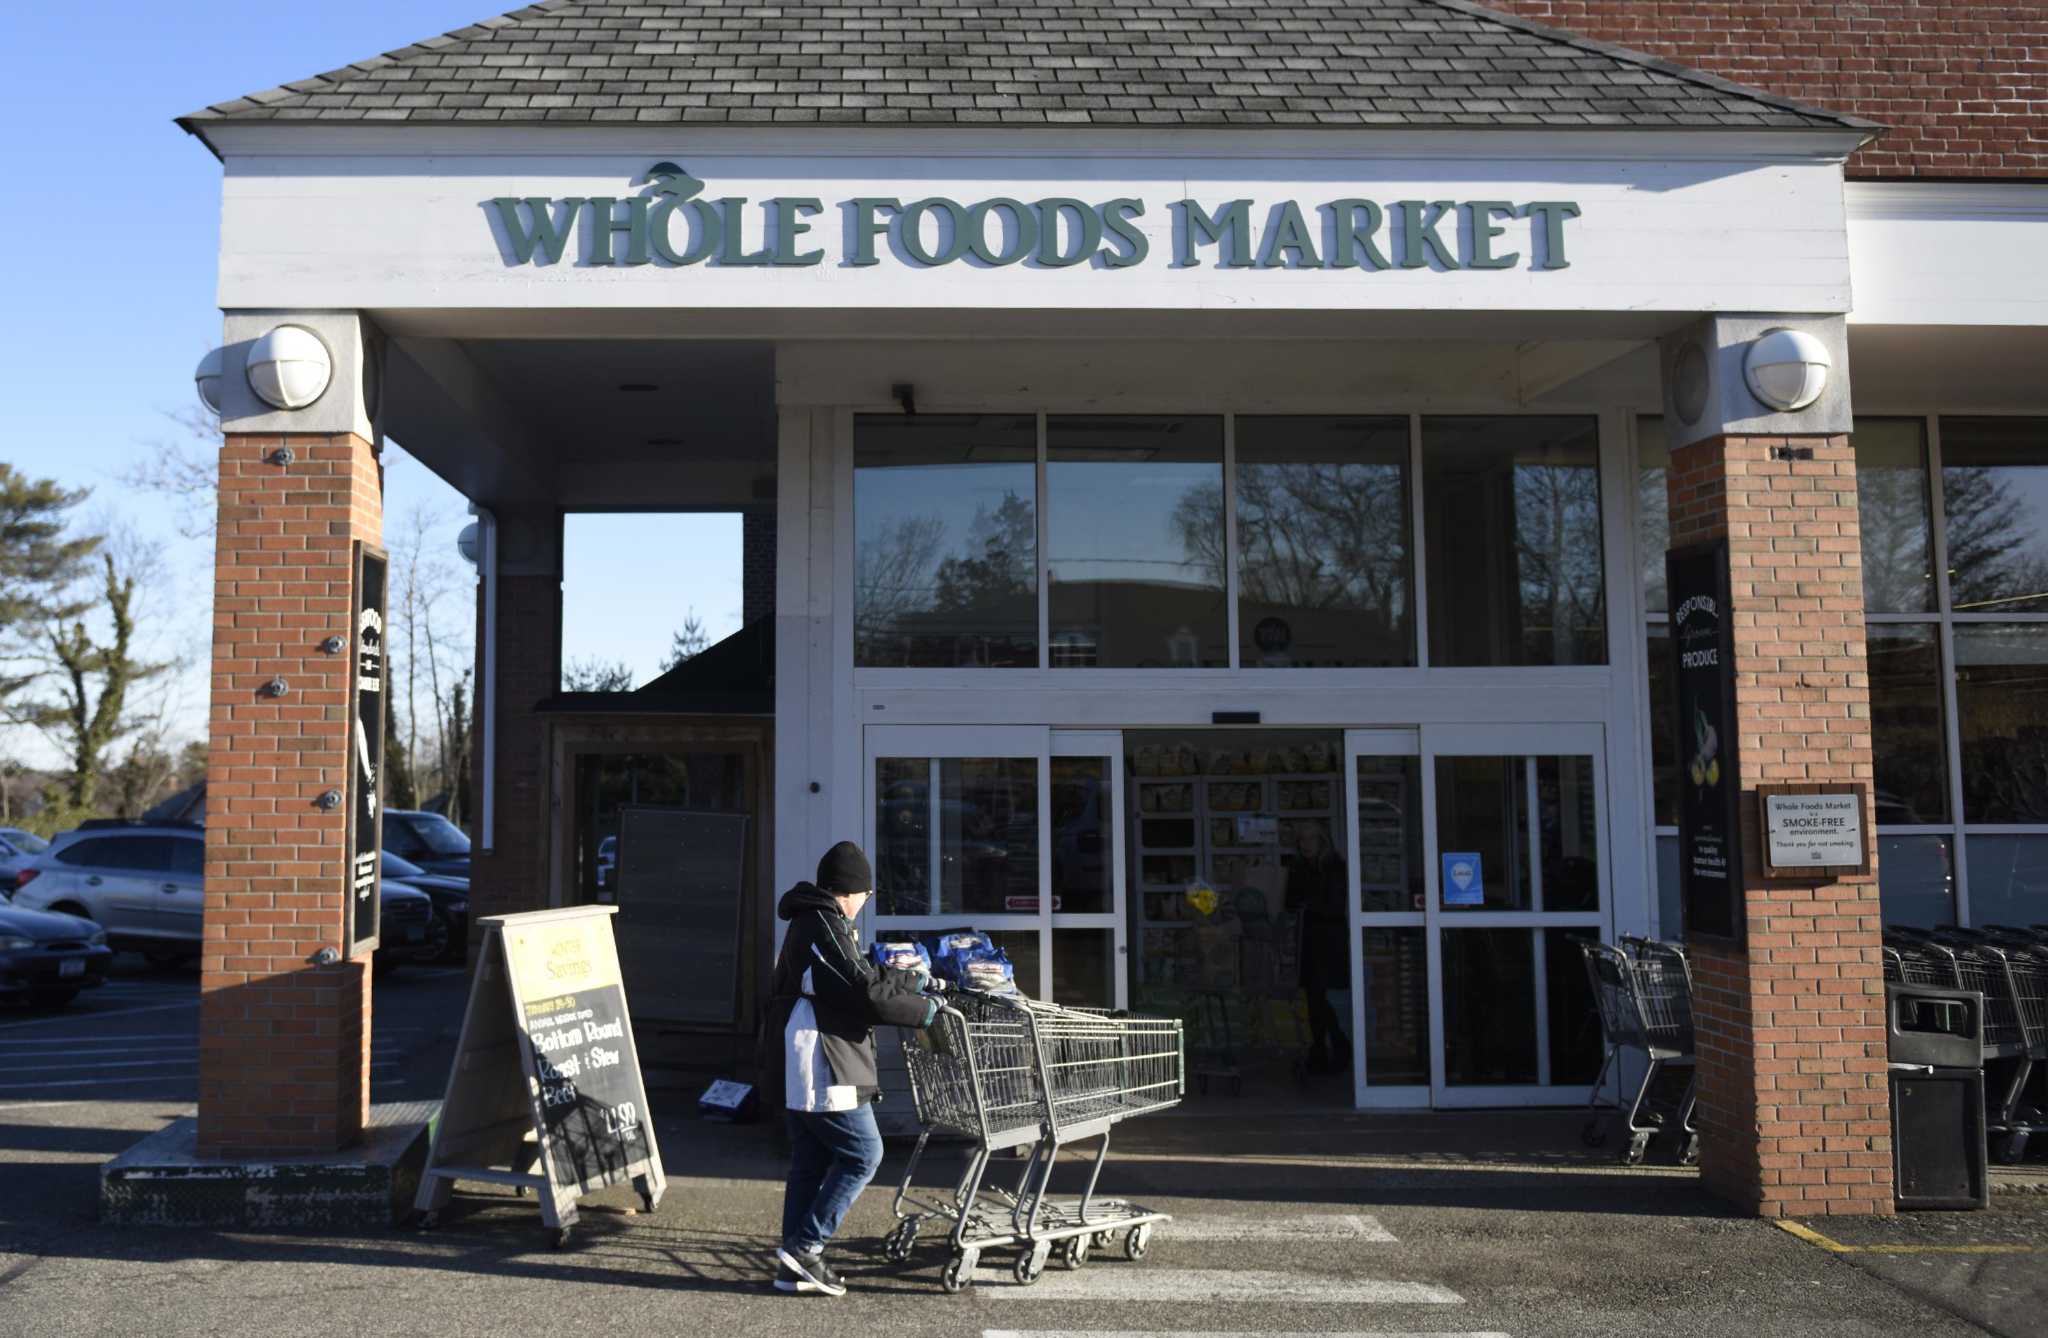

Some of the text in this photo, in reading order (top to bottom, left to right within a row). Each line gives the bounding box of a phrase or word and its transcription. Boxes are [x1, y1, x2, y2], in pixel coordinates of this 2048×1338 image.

[492, 188, 1582, 271] WHOLE FOODS MARKET
[1682, 648, 1719, 668] PRODUCE
[1775, 801, 1851, 811] Whole Foods Market
[1782, 817, 1845, 828] SMOKE-FREE
[1807, 841, 1816, 849] for
[545, 959, 592, 981] Savings
[531, 1017, 624, 1054] Bottom Round
[537, 1054, 581, 1082] Roast
[590, 1046, 620, 1069] Stew
[543, 1080, 577, 1107] Beef
